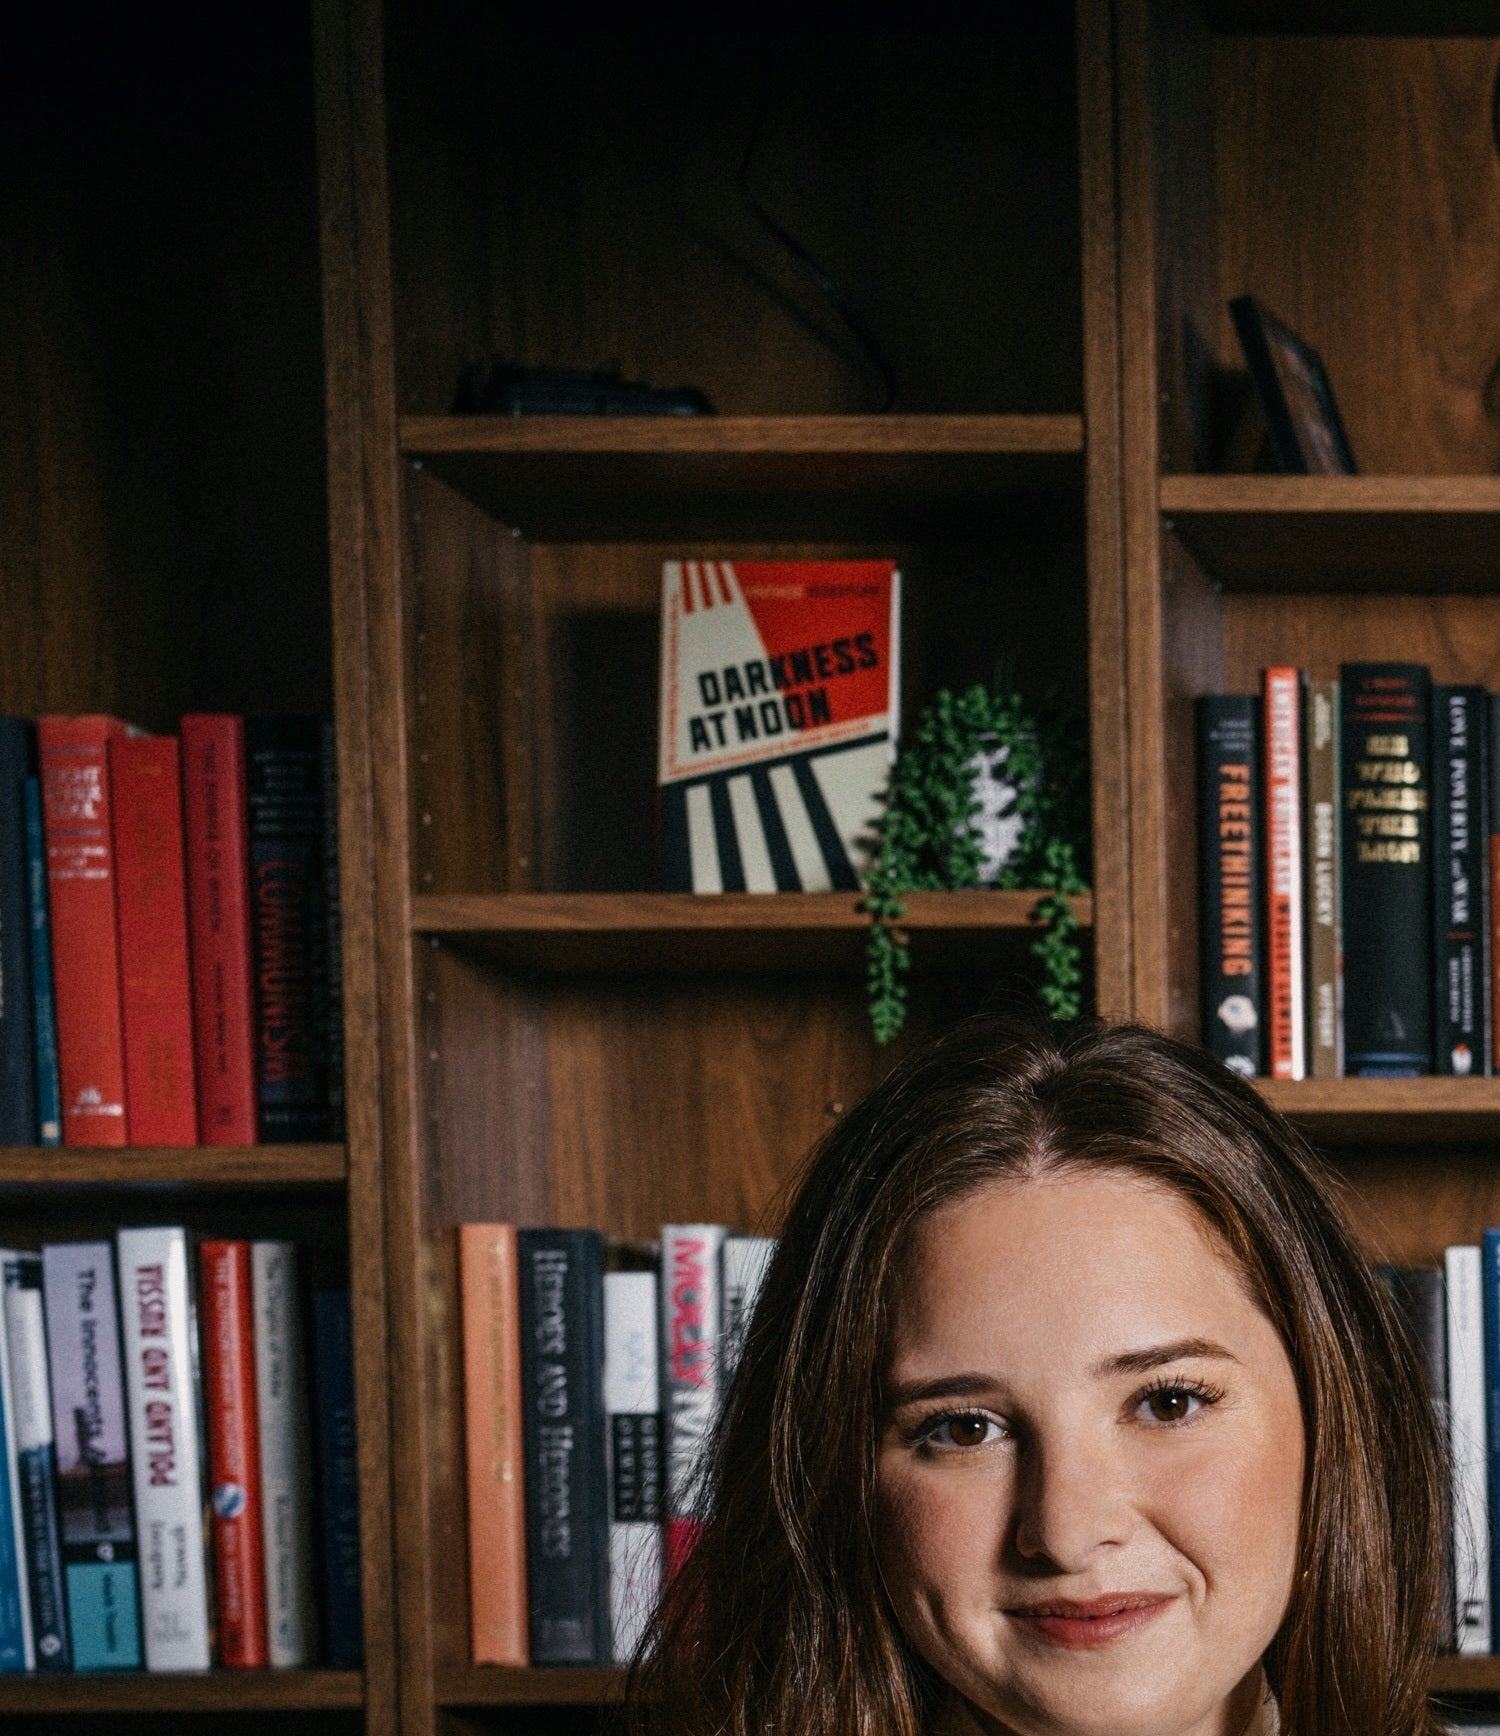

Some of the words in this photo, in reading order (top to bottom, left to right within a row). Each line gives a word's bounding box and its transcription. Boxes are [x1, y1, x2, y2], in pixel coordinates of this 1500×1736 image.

[697, 633, 878, 707] DARKNESS
[688, 709, 728, 754] AT
[733, 687, 831, 741] NOON
[1314, 801, 1333, 863] BORN
[1449, 757, 1469, 852] POVERTY
[1217, 763, 1254, 978] FREETHINKING
[1314, 866, 1333, 926] LUCKY
[1450, 877, 1469, 925] WAR
[259, 862, 305, 1083] COMMUNISM
[75, 1269, 94, 1312] The
[137, 1263, 164, 1337] RUSSIA
[670, 1237, 713, 1391] MOLLY
[77, 1317, 107, 1440] Innocents
[142, 1349, 170, 1391] AND
[537, 1364, 568, 1418] AND
[148, 1404, 177, 1487] POLAND
[617, 1415, 635, 1517] ORWELL
[640, 1414, 657, 1517] GEORGE
